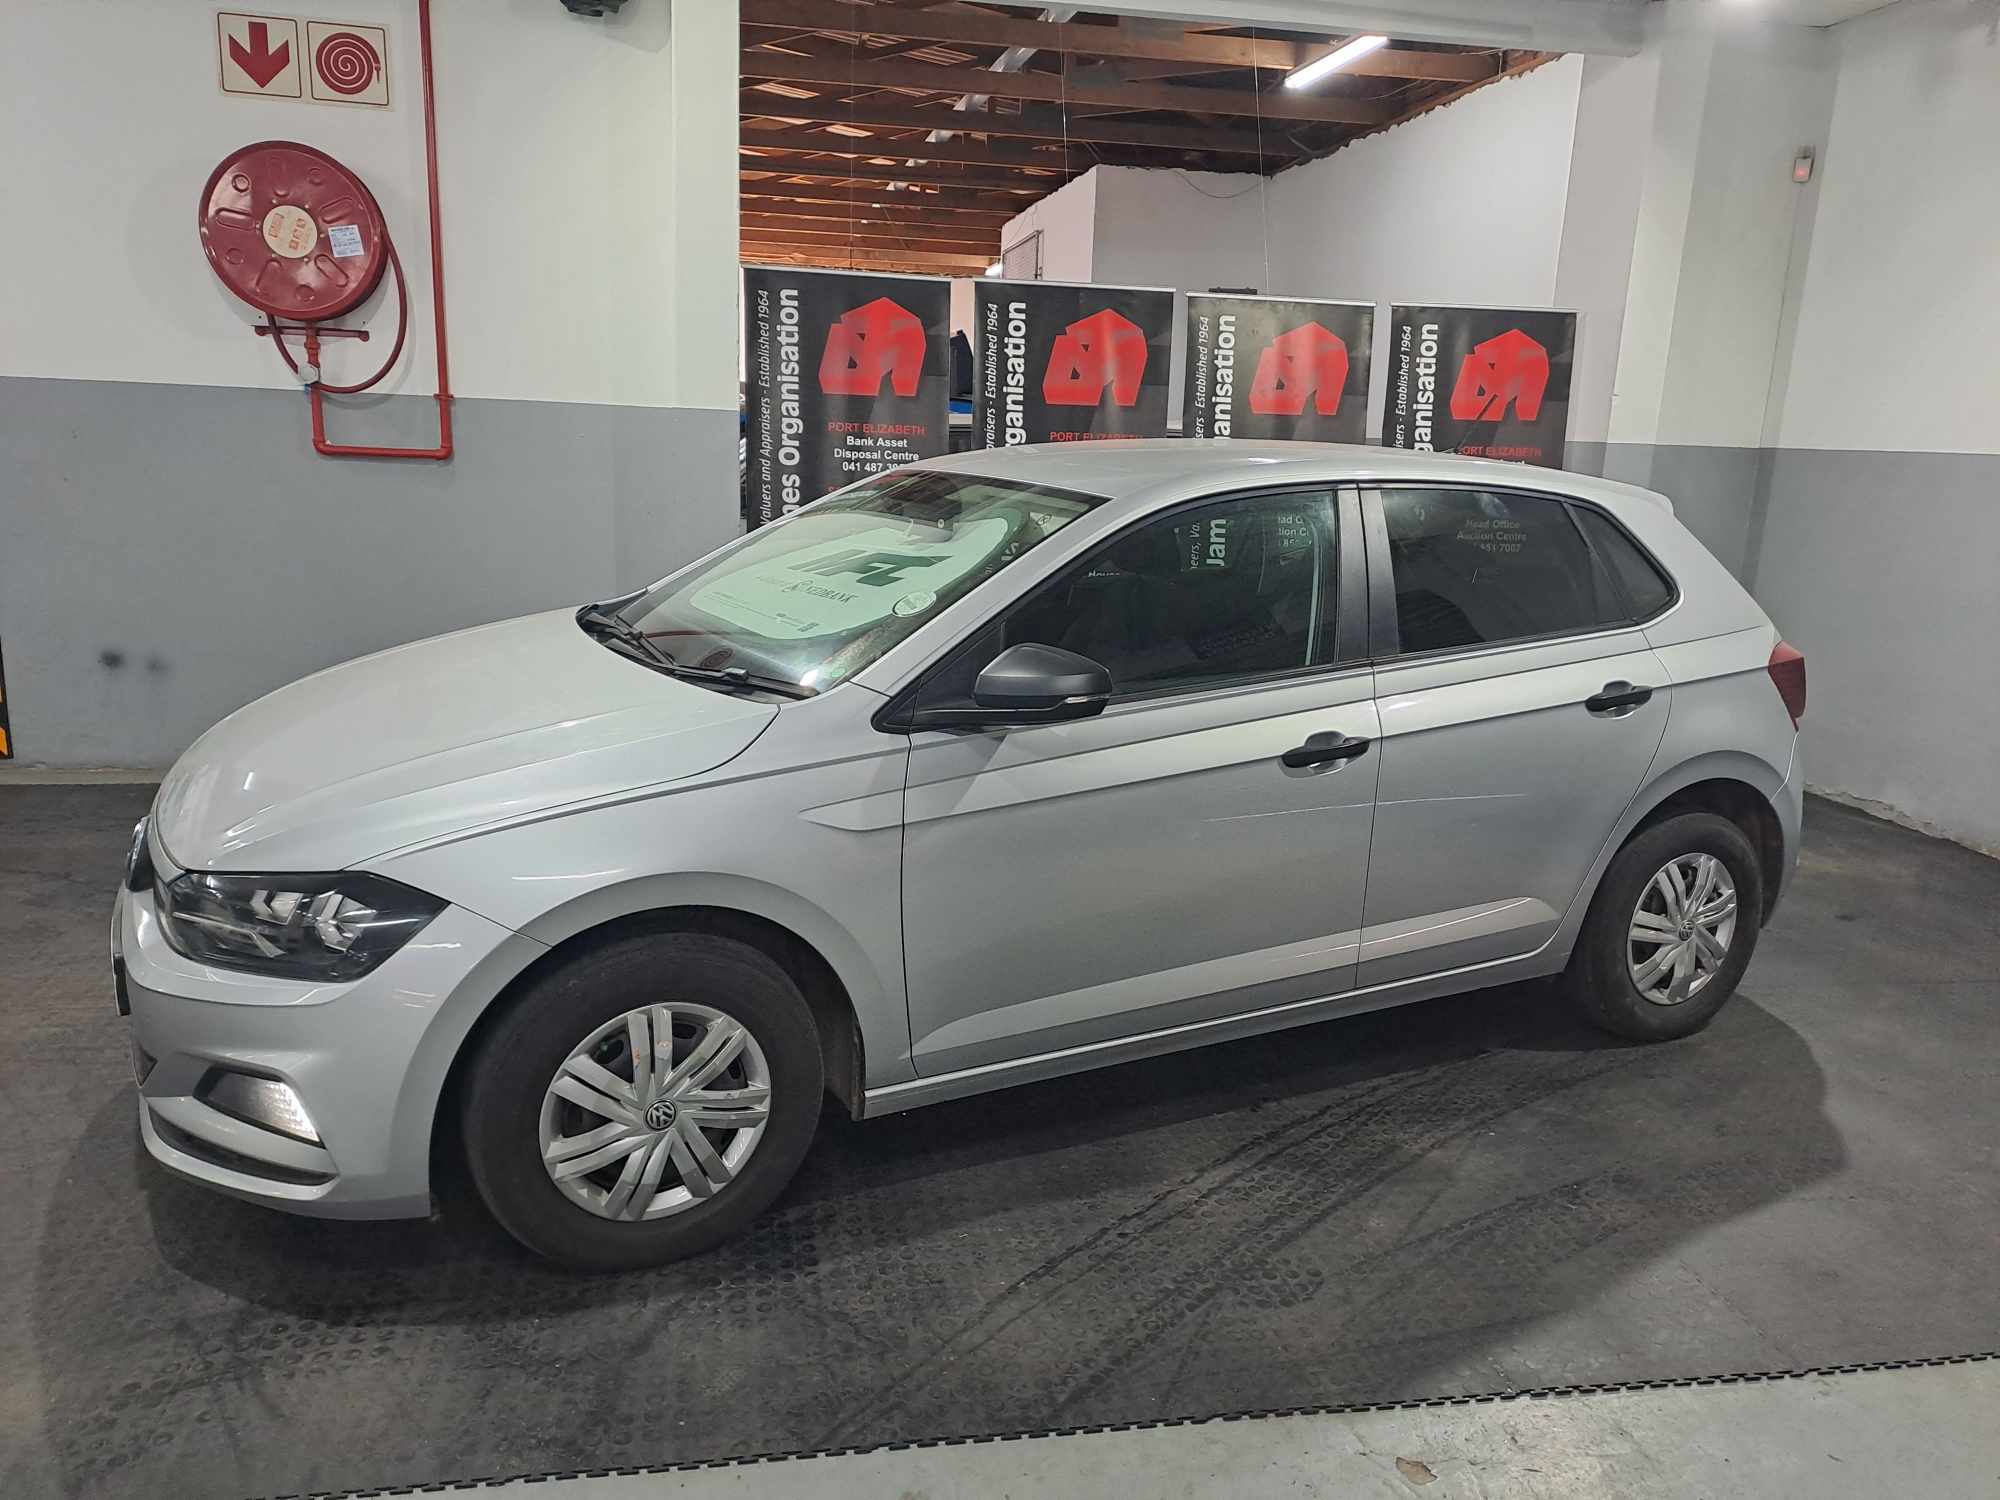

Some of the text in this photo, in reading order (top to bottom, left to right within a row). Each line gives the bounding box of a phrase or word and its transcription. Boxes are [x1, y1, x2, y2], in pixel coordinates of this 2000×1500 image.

[758, 288, 769, 318] 1964
[987, 303, 999, 331] 1964
[1198, 315, 1209, 344] 1964
[1401, 325, 1412, 352] 1964
[758, 321, 770, 387] Established
[985, 333, 998, 399] Established
[776, 288, 803, 466] Organisation
[1003, 302, 1027, 447] ganisation
[1195, 345, 1208, 409] Established
[1212, 315, 1236, 440] anisation
[1396, 354, 1409, 416] Established
[758, 396, 773, 457] Appraisers
[827, 422, 925, 435] PORT ELIZABETH
[1049, 431, 1080, 441] PORT
[1193, 417, 1204, 440] sers
[833, 448, 919, 461] Disposal Centre
[846, 435, 908, 448] Bank Asset
[760, 459, 771, 480] and
[842, 461, 861, 472] 041
[864, 462, 883, 473] 487
[760, 484, 772, 525] Valuers
